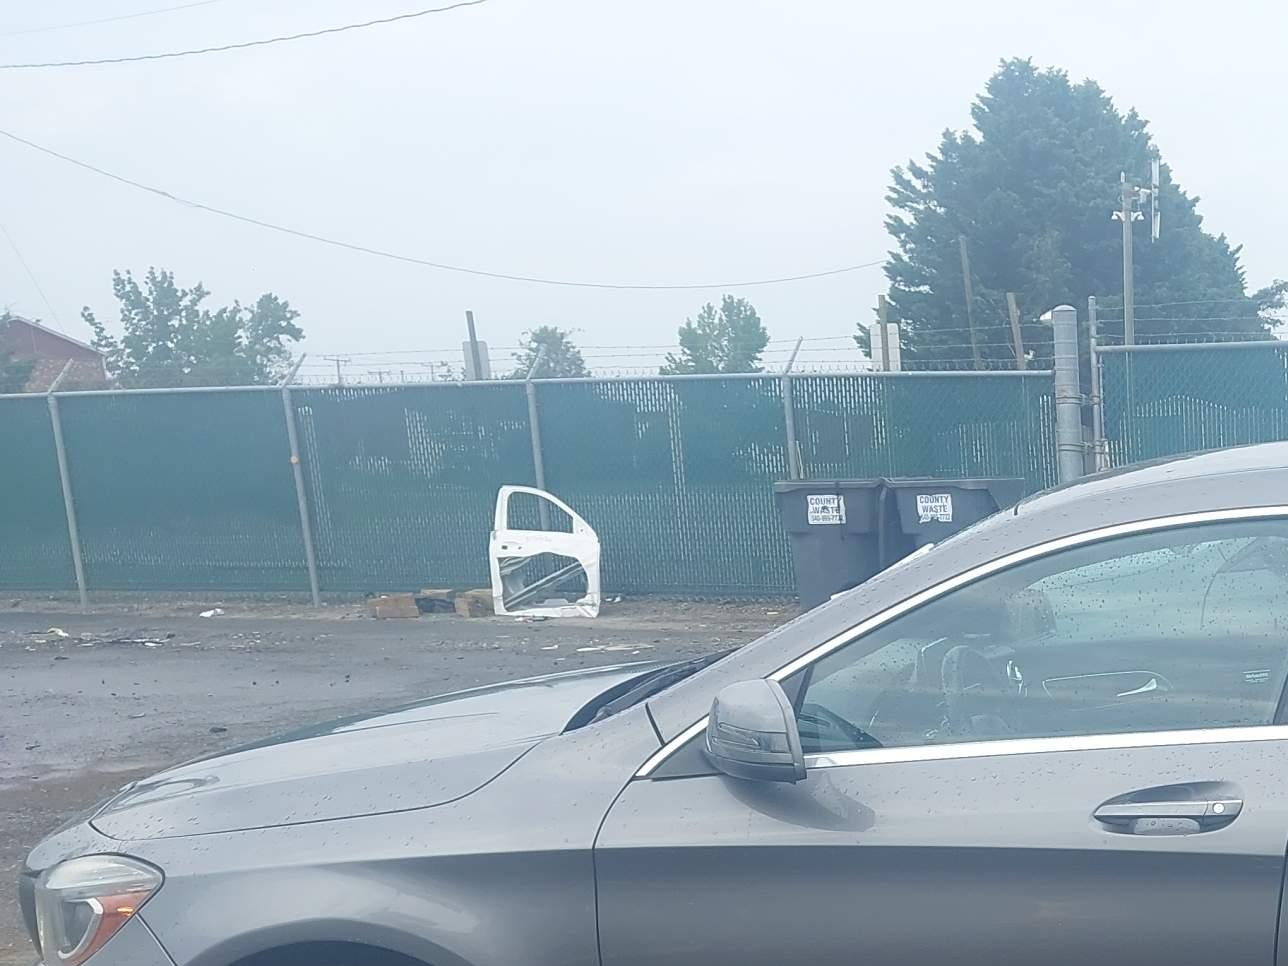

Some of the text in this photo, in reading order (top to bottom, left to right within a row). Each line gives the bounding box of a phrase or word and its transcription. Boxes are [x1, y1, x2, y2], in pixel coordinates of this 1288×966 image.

[810, 496, 842, 505] COUNTY
[919, 495, 949, 504] COUNTY
[812, 505, 841, 513] WASTE
[921, 504, 949, 513] WASTE
